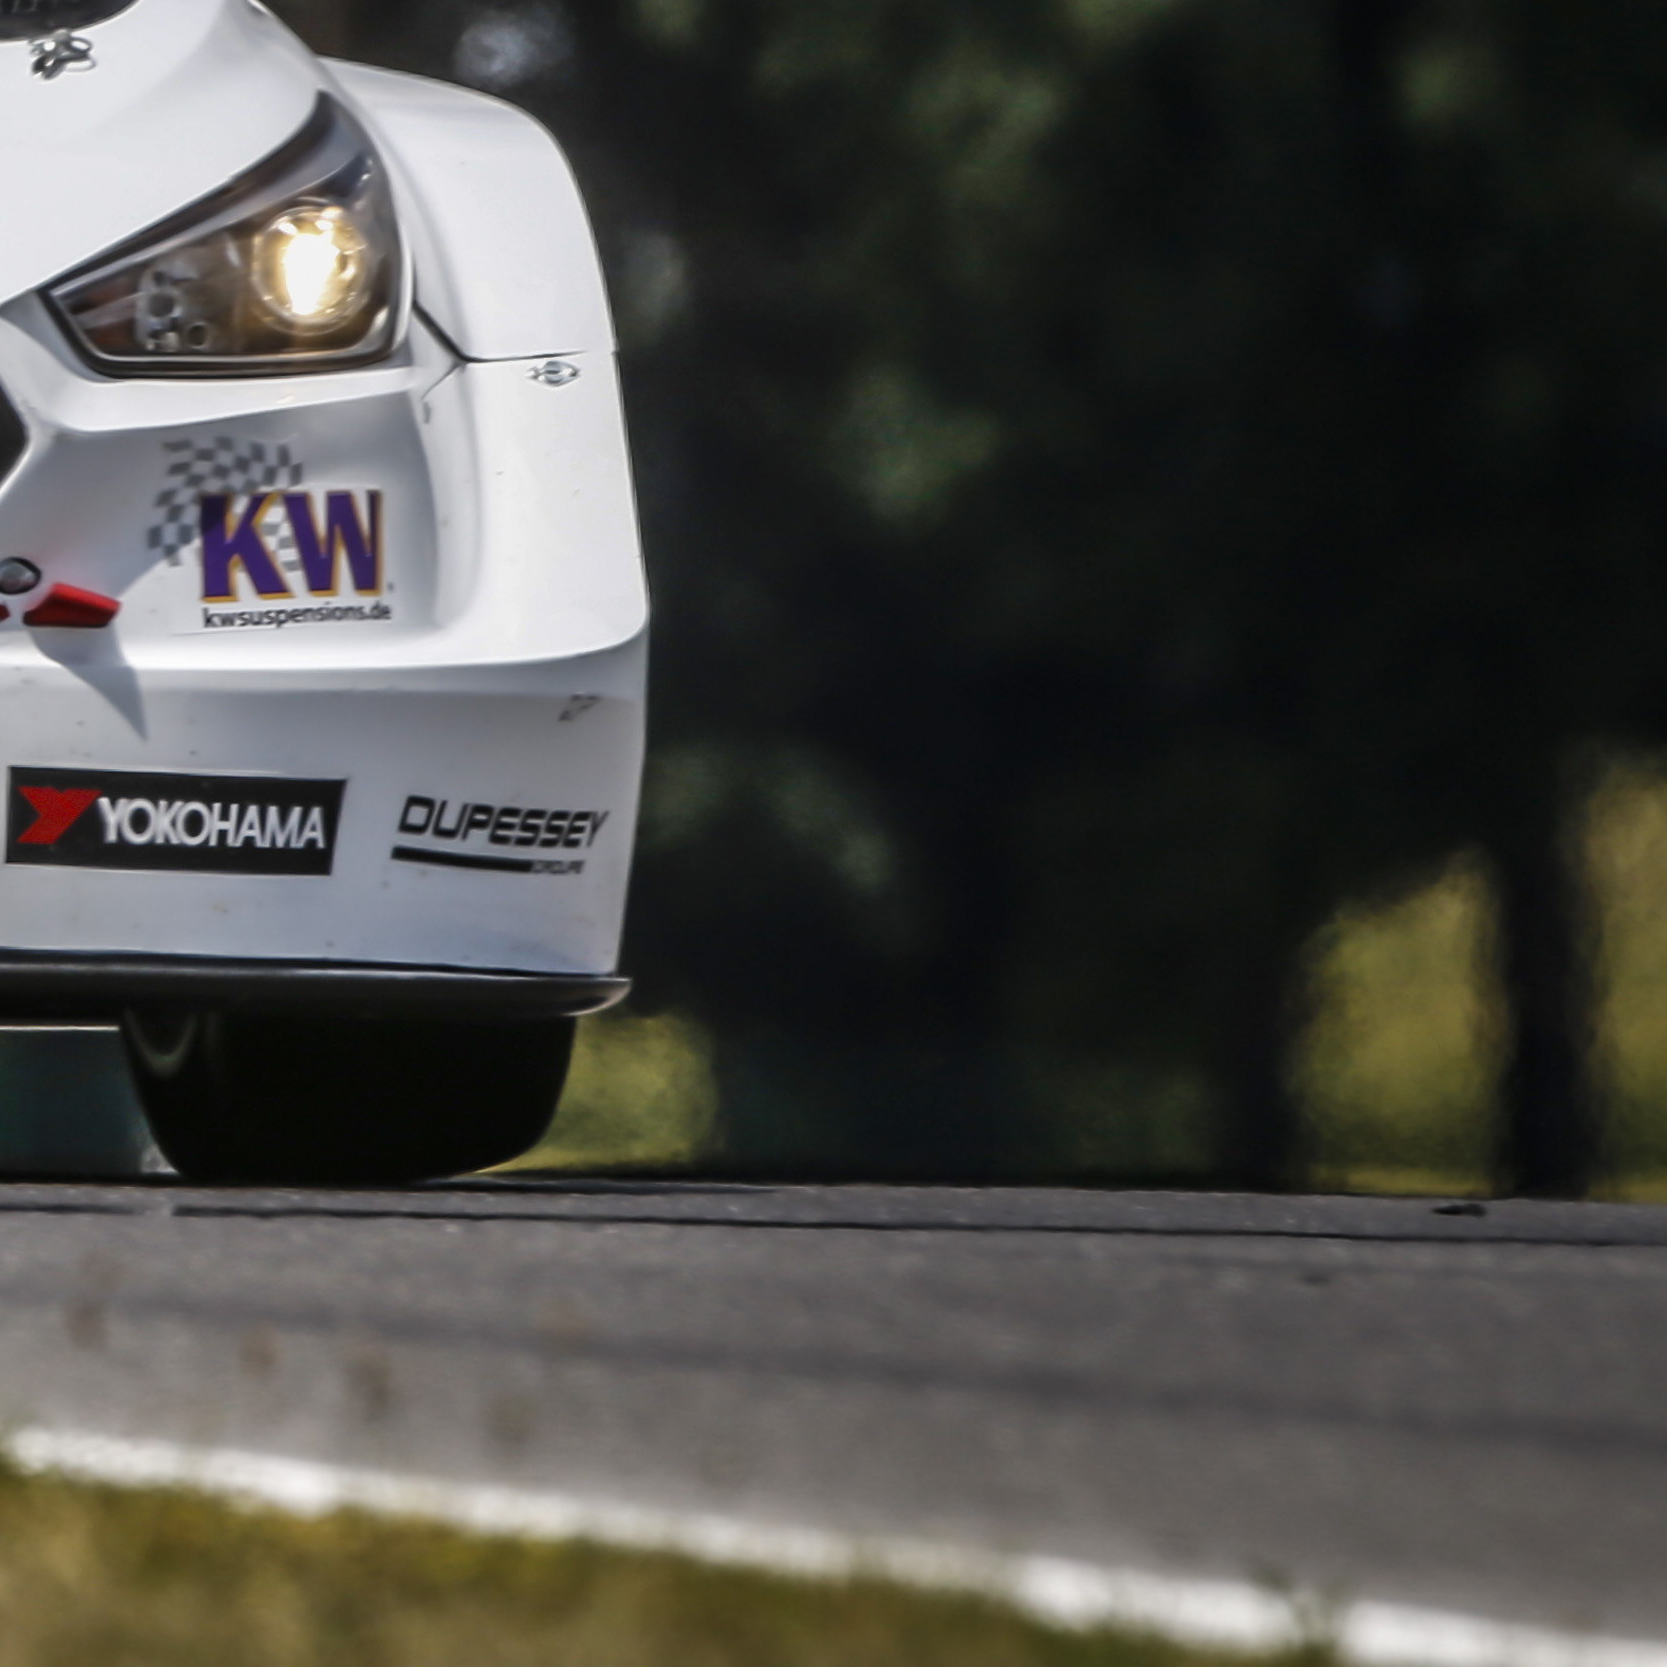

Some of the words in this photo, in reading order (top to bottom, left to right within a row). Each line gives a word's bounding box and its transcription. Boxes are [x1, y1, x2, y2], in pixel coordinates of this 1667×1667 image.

[198, 489, 385, 604] KW
[201, 600, 393, 630] kwsuspensions.de
[97, 796, 326, 851] YOKOHAMA
[397, 794, 611, 850] DUPESSEY
